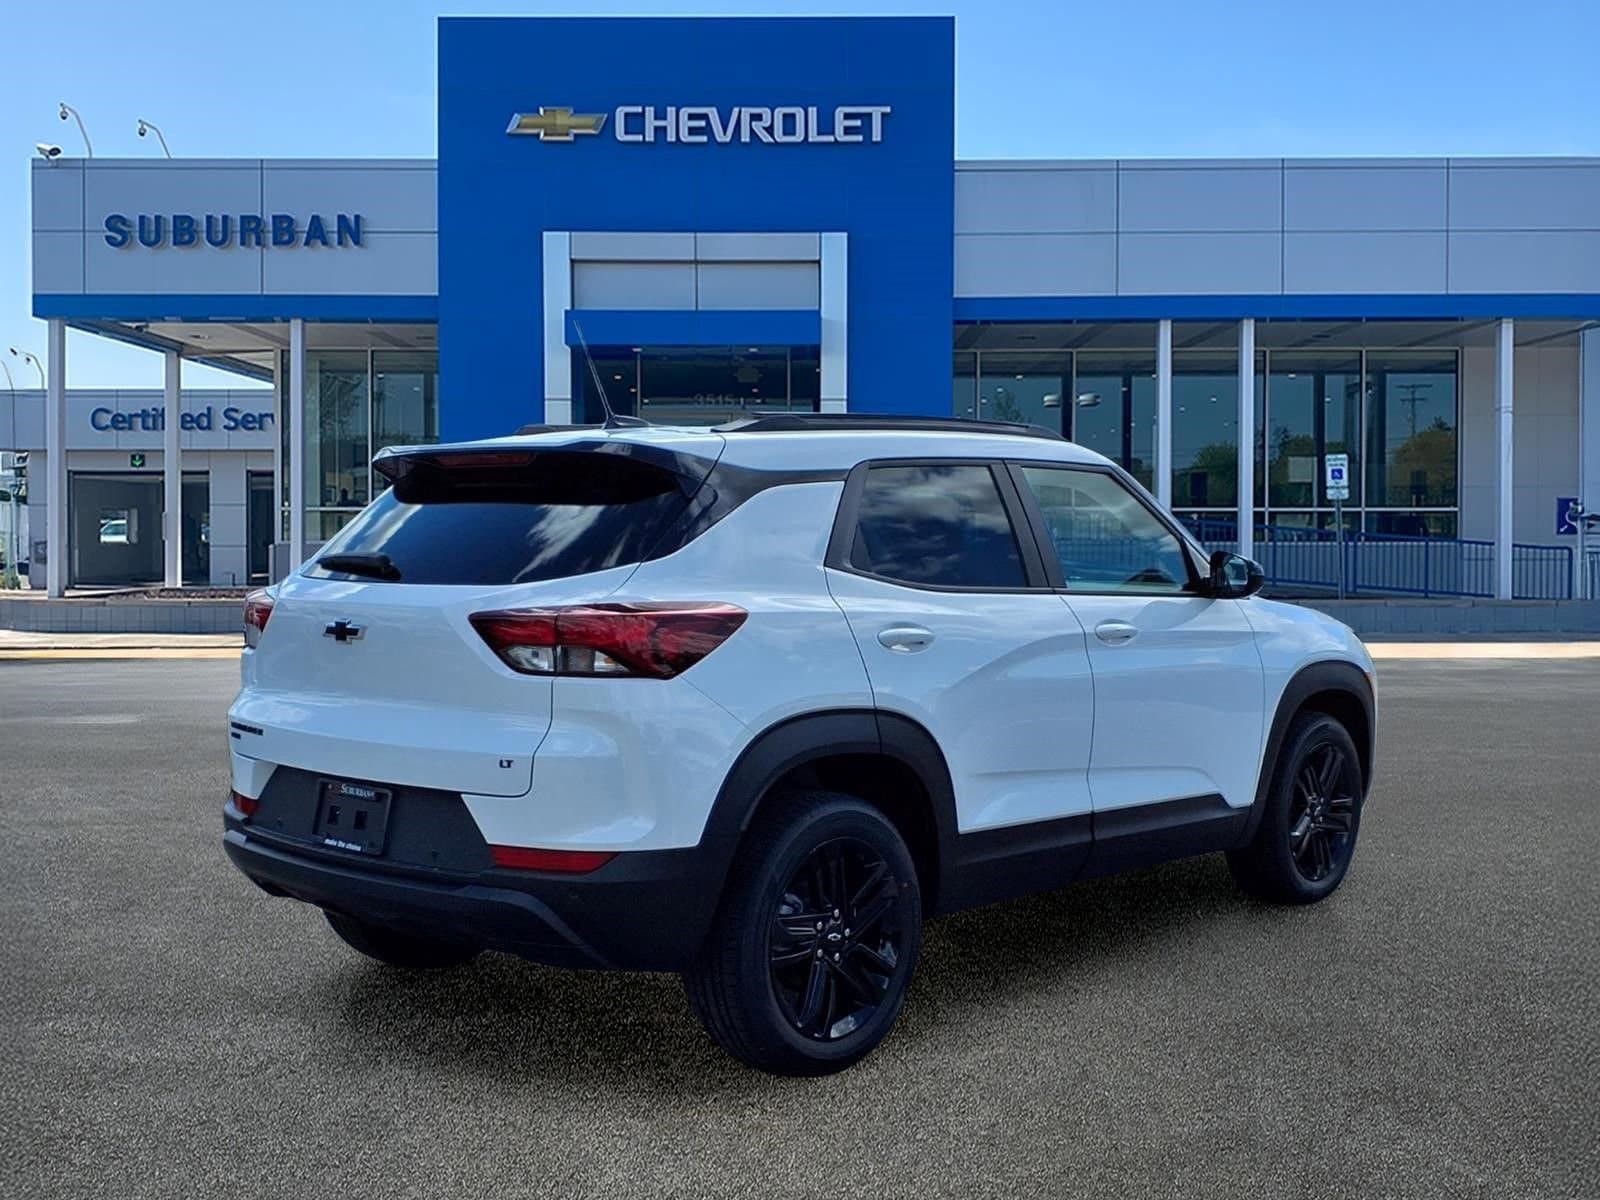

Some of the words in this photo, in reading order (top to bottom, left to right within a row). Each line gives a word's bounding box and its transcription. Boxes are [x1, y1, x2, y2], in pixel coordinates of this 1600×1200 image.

[615, 105, 892, 144] CHEVROLET
[104, 213, 363, 248] SUBURBAN
[499, 759, 514, 769] LT
